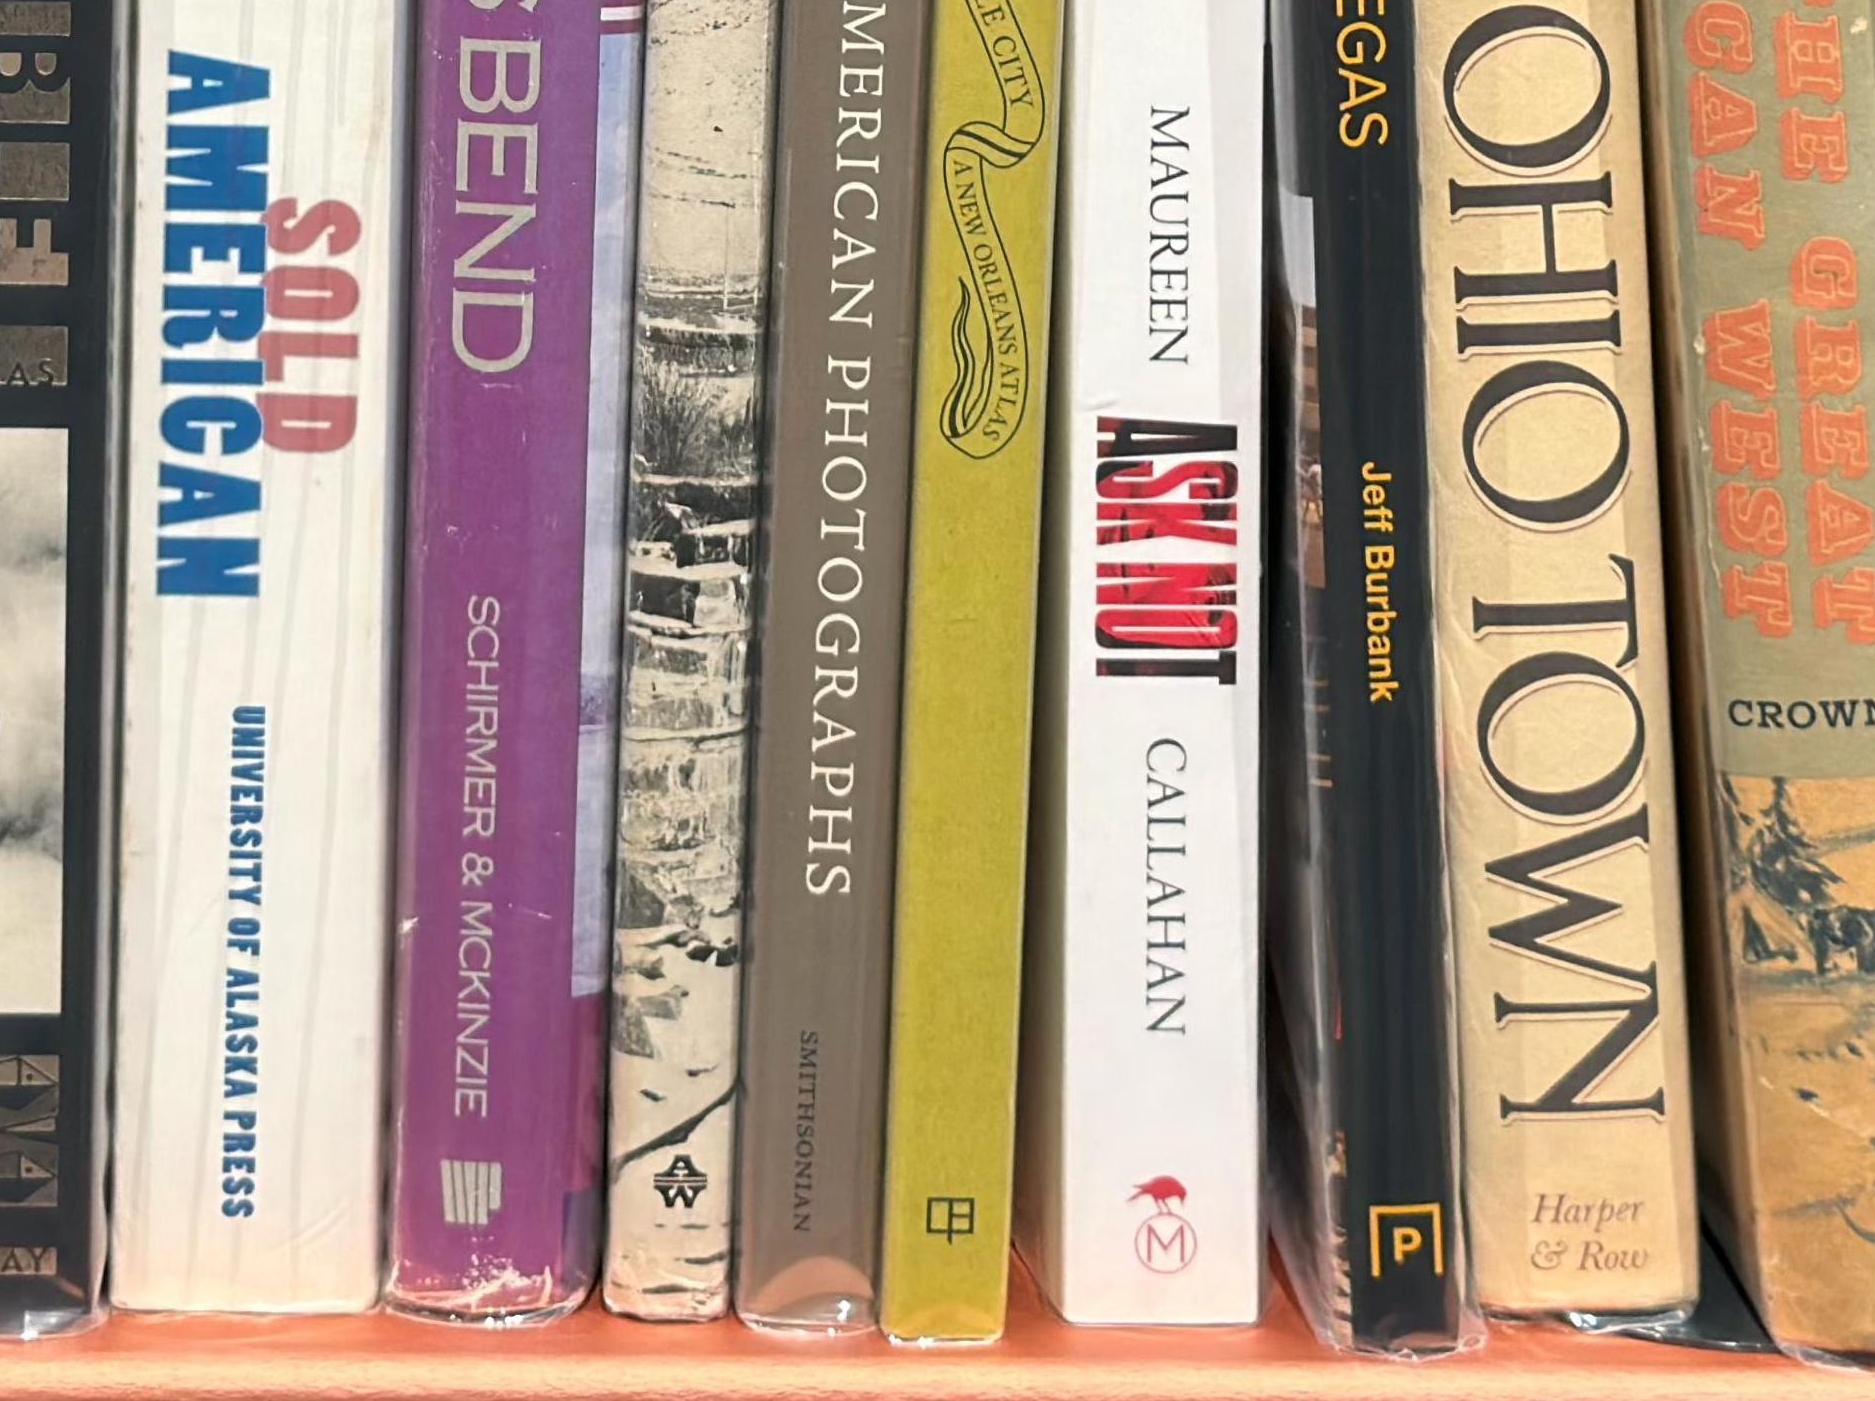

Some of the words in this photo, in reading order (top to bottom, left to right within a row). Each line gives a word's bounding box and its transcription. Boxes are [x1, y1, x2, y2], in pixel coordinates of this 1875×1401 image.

[992, 35, 1035, 108] CITY
[452, 36, 542, 374] BEND
[953, 160, 973, 177] A
[956, 181, 987, 236] NEW
[973, 243, 1018, 355] ORLEANS
[1149, 105, 1191, 366] MAUREEN
[1442, 3, 1631, 529] OHIO
[156, 49, 271, 598] AMERICAN
[259, 196, 362, 456] SOLD
[983, 362, 1020, 442] ATLAS
[1703, 298, 1794, 638] WEST
[1095, 415, 1238, 546] ASK
[1360, 460, 1394, 536] Jeff
[806, 354, 872, 896] PHOTOGRAPHS
[1095, 562, 1238, 685] NOT
[1364, 543, 1396, 704] Burbank
[462, 594, 500, 841] SCHIRMER
[224, 705, 267, 907] UNIVERSITY
[462, 851, 494, 885] &
[1472, 553, 1666, 1122] TOWN
[226, 916, 262, 957] OF
[1146, 736, 1187, 1037] CALLAHAN
[223, 966, 261, 1099] ALASKA
[454, 900, 493, 1119] MCKINZIE
[220, 1110, 258, 1219] PRESS
[794, 1031, 818, 1232] SMITHSONIAN
[1145, 1224, 1186, 1264] M
[1529, 1239, 1569, 1273] &
[1578, 1241, 1649, 1274] Row
[1531, 1194, 1646, 1230] Harper
